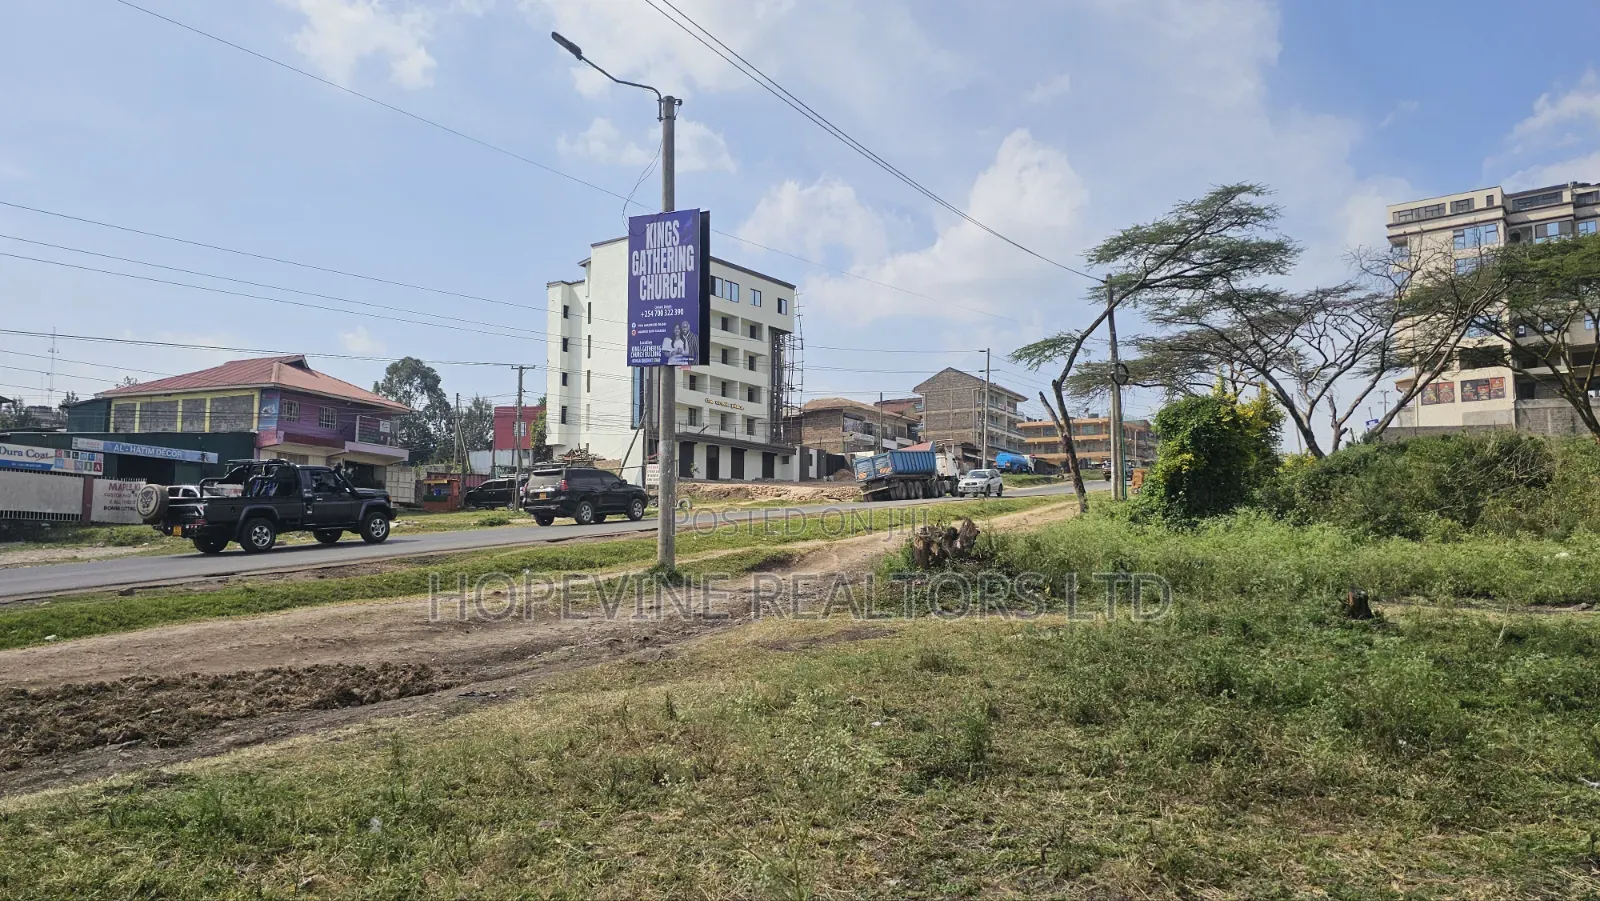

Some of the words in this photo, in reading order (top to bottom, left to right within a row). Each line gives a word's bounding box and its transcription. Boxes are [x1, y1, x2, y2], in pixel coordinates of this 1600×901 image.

[646, 220, 680, 249] KINGS
[632, 245, 695, 277] GATHERING
[640, 271, 686, 301] CHURCH
[0, 445, 23, 457] Dura
